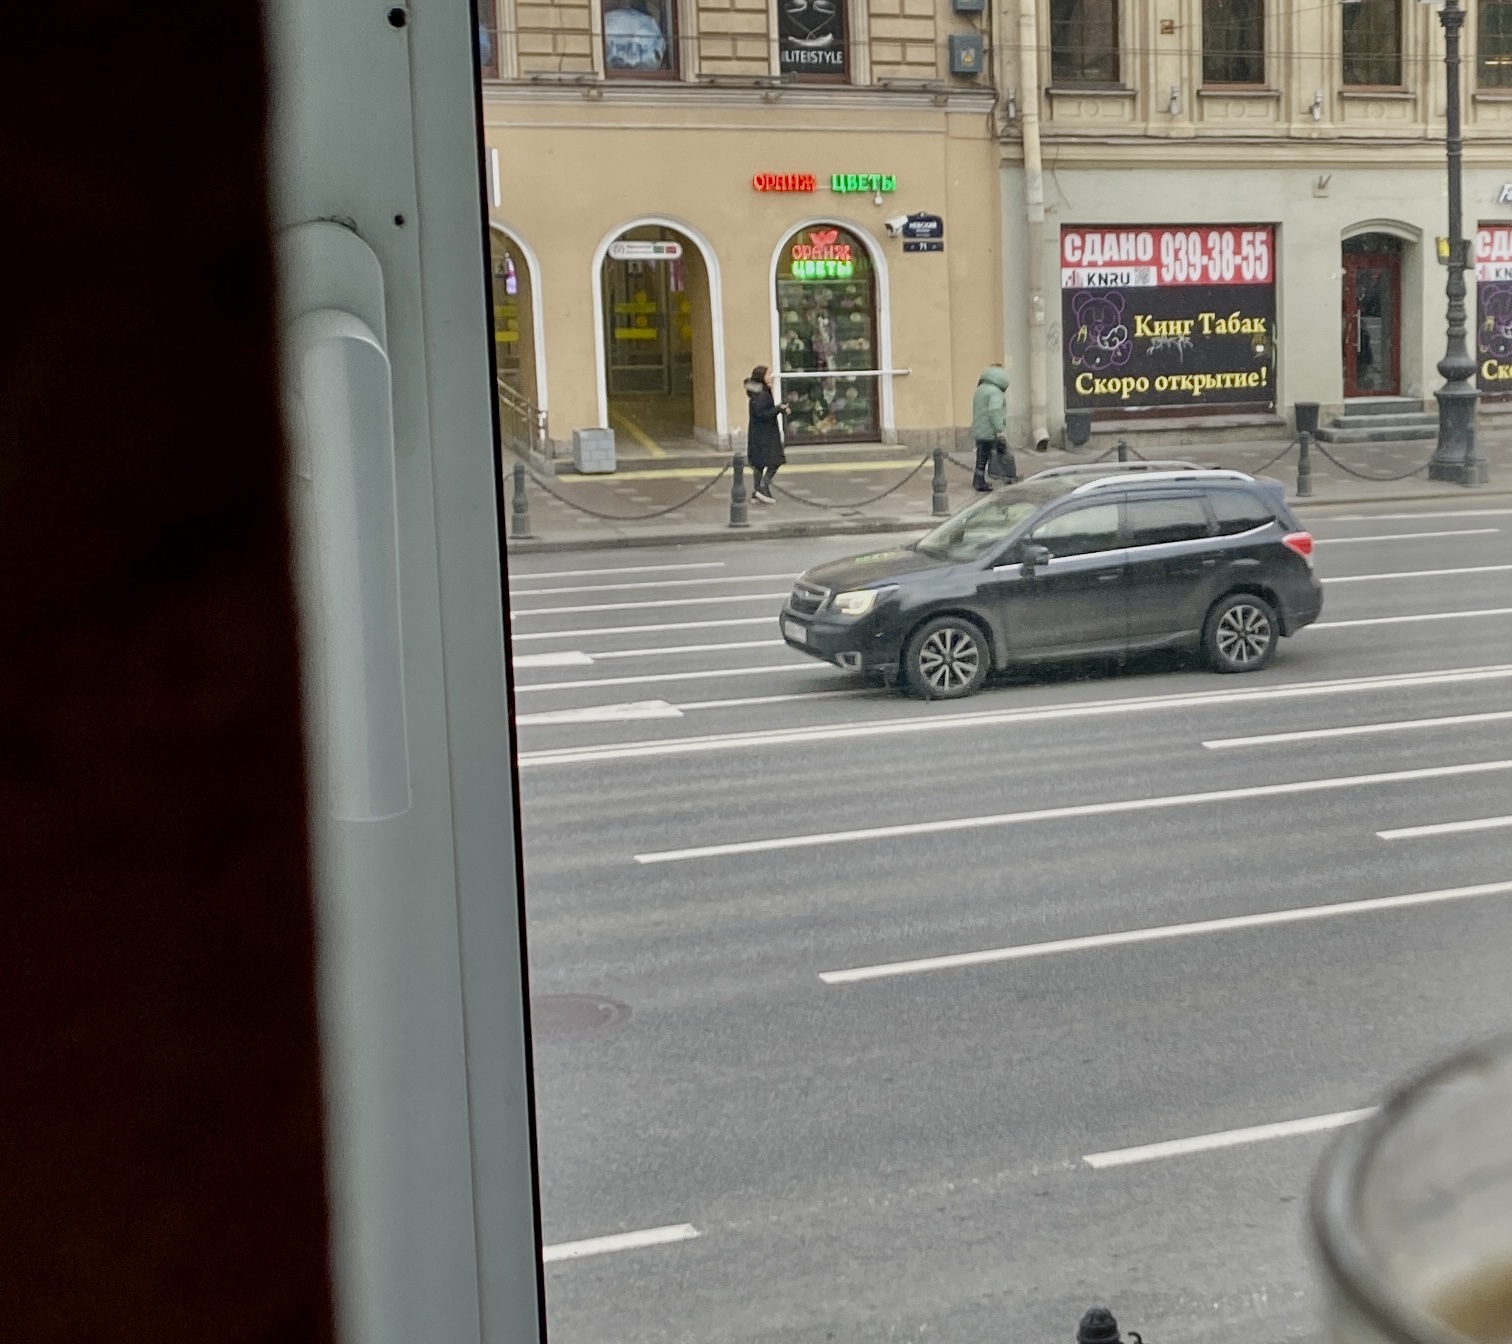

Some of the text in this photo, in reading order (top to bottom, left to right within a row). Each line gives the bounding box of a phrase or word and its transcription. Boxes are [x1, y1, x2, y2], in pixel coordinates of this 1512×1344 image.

[753, 172, 897, 194] ОРАНЖ ЦВЕТЫ
[792, 244, 852, 261] ОРАНЖ
[1064, 230, 1269, 282] СДАНО 939-38-55
[792, 260, 854, 279] ЦВЕТЫ
[1087, 272, 1130, 287] KNRU
[1134, 311, 1267, 337] Кинг Табак
[1075, 366, 1268, 399] Скоро открытие!
